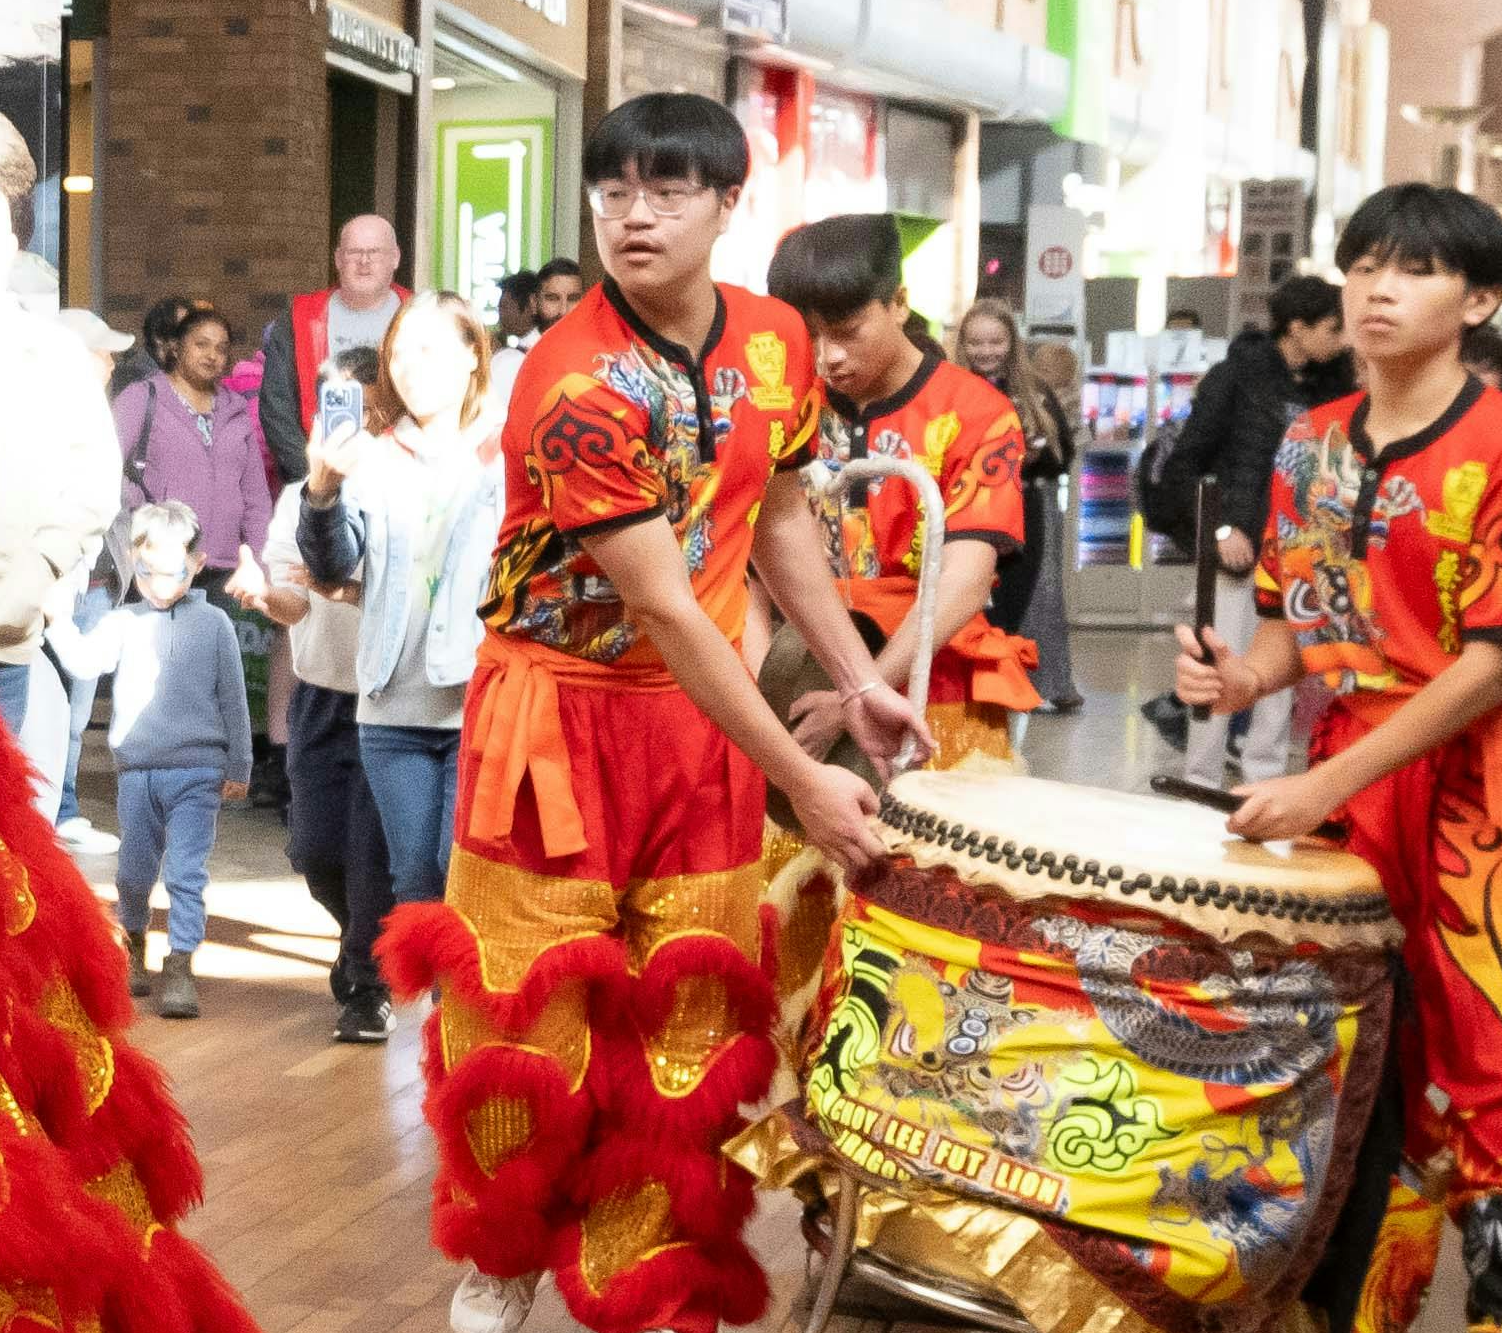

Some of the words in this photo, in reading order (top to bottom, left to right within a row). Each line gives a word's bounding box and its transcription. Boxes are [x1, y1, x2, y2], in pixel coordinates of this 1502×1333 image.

[830, 1097, 880, 1135] CHOY
[884, 1119, 927, 1155] LEE
[933, 1139, 987, 1177] FUT
[994, 1161, 1062, 1205] LION
